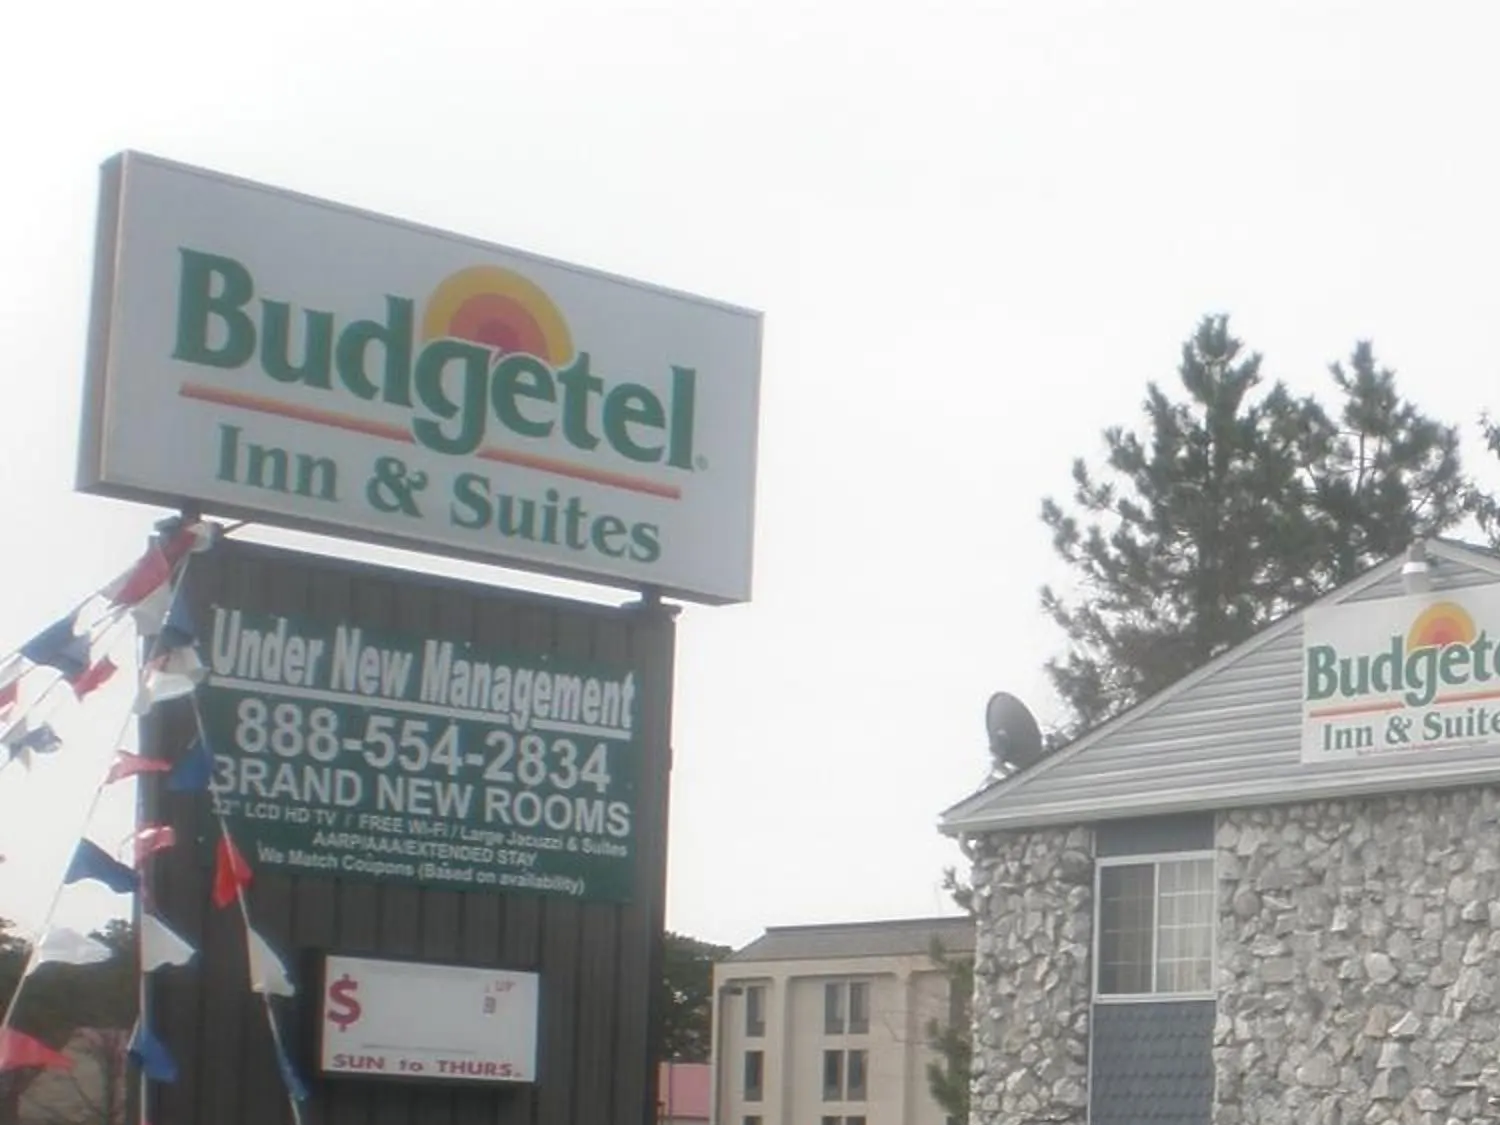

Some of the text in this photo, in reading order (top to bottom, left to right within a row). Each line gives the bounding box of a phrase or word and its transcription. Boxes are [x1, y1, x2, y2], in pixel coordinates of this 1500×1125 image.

[170, 247, 697, 471] Budgetel
[215, 424, 662, 565] Inn & Suites
[210, 608, 637, 731] Under New Management
[235, 699, 612, 794] 888-554-2834
[1323, 723, 1374, 751] Inn
[1385, 715, 1413, 746] &
[209, 755, 632, 838] BRAND NEW ROOMS
[245, 801, 281, 820] LCD
[285, 805, 312, 823] HD
[314, 808, 338, 828] TV
[358, 812, 403, 833] FREE
[460, 827, 503, 849] Large
[566, 836, 580, 853] &
[581, 838, 628, 857] Suites
[497, 849, 537, 867] STAY
[288, 849, 337, 872] Match
[341, 853, 415, 879] Coupons
[418, 861, 472, 883] (Based
[476, 869, 497, 884] on
[498, 870, 585, 895] availability)
[327, 974, 361, 1032] $
[332, 1053, 385, 1070] SUN
[400, 1060, 424, 1072] to
